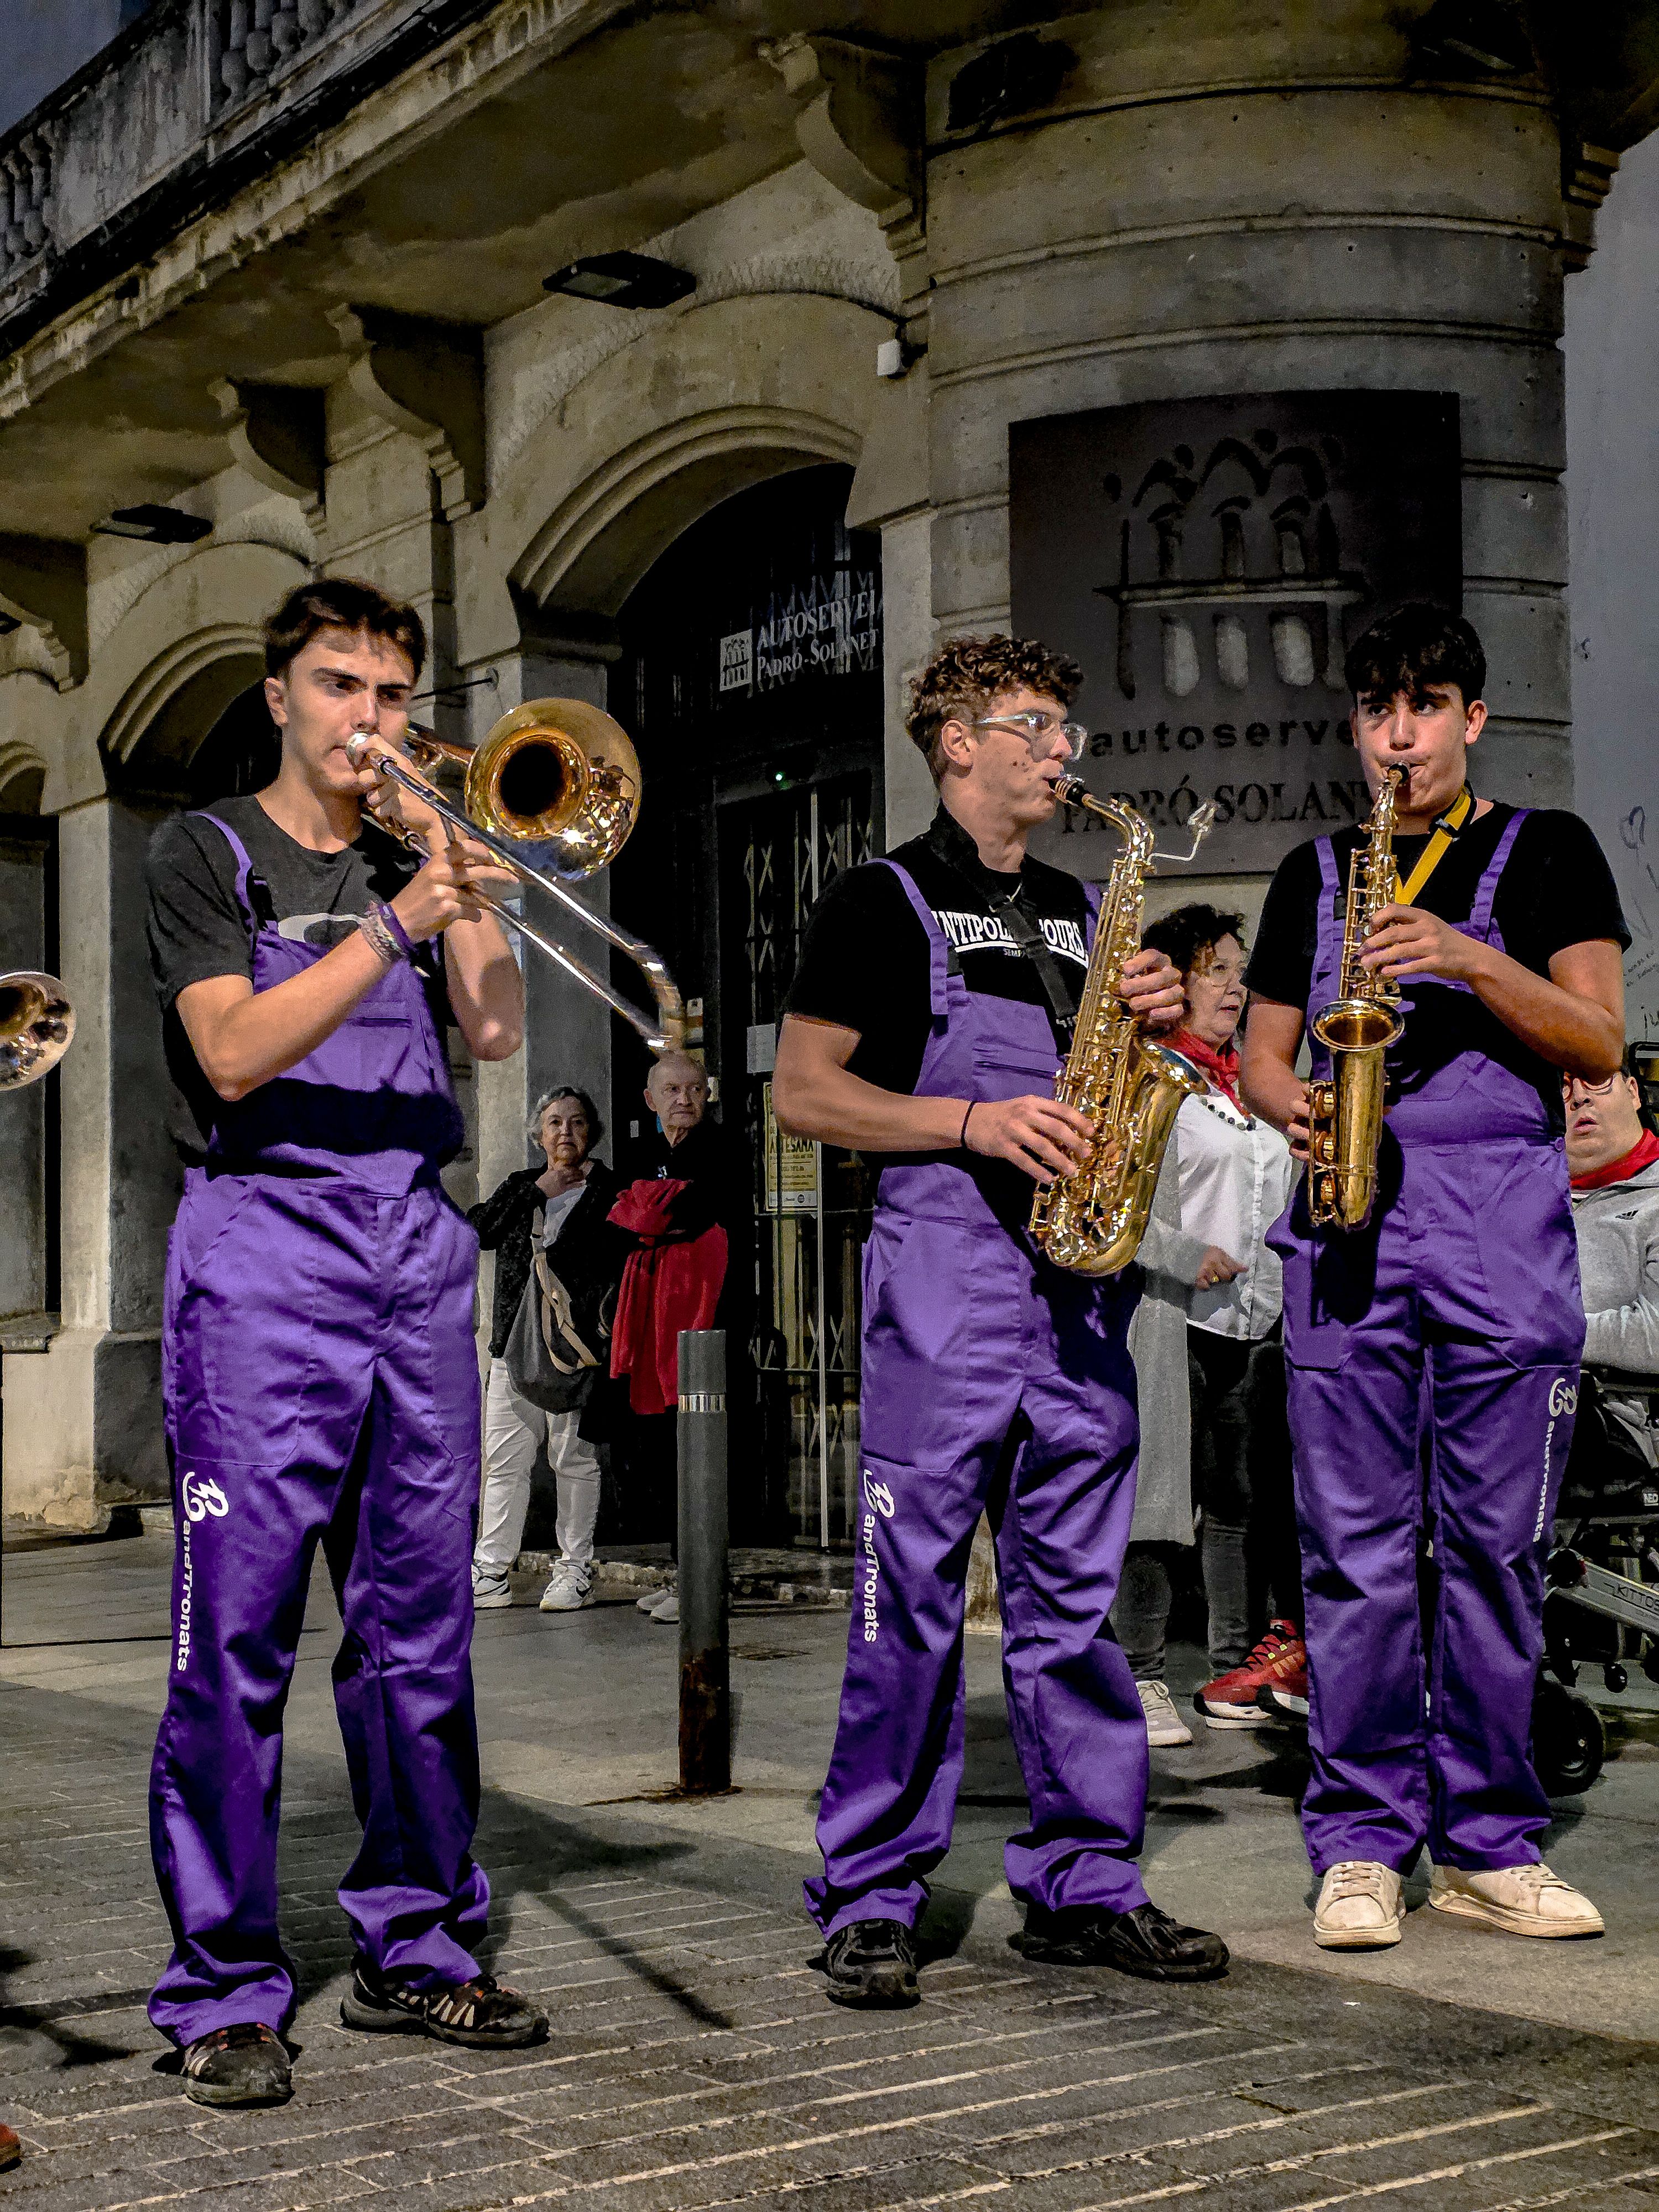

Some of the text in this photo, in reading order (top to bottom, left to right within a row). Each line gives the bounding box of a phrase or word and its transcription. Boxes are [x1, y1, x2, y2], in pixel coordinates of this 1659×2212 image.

[757, 589, 875, 650] AUTOSERVEI
[1089, 719, 1354, 757] autoserve
[1214, 780, 1375, 823] SOLAN
[1038, 919, 1085, 958] OURS
